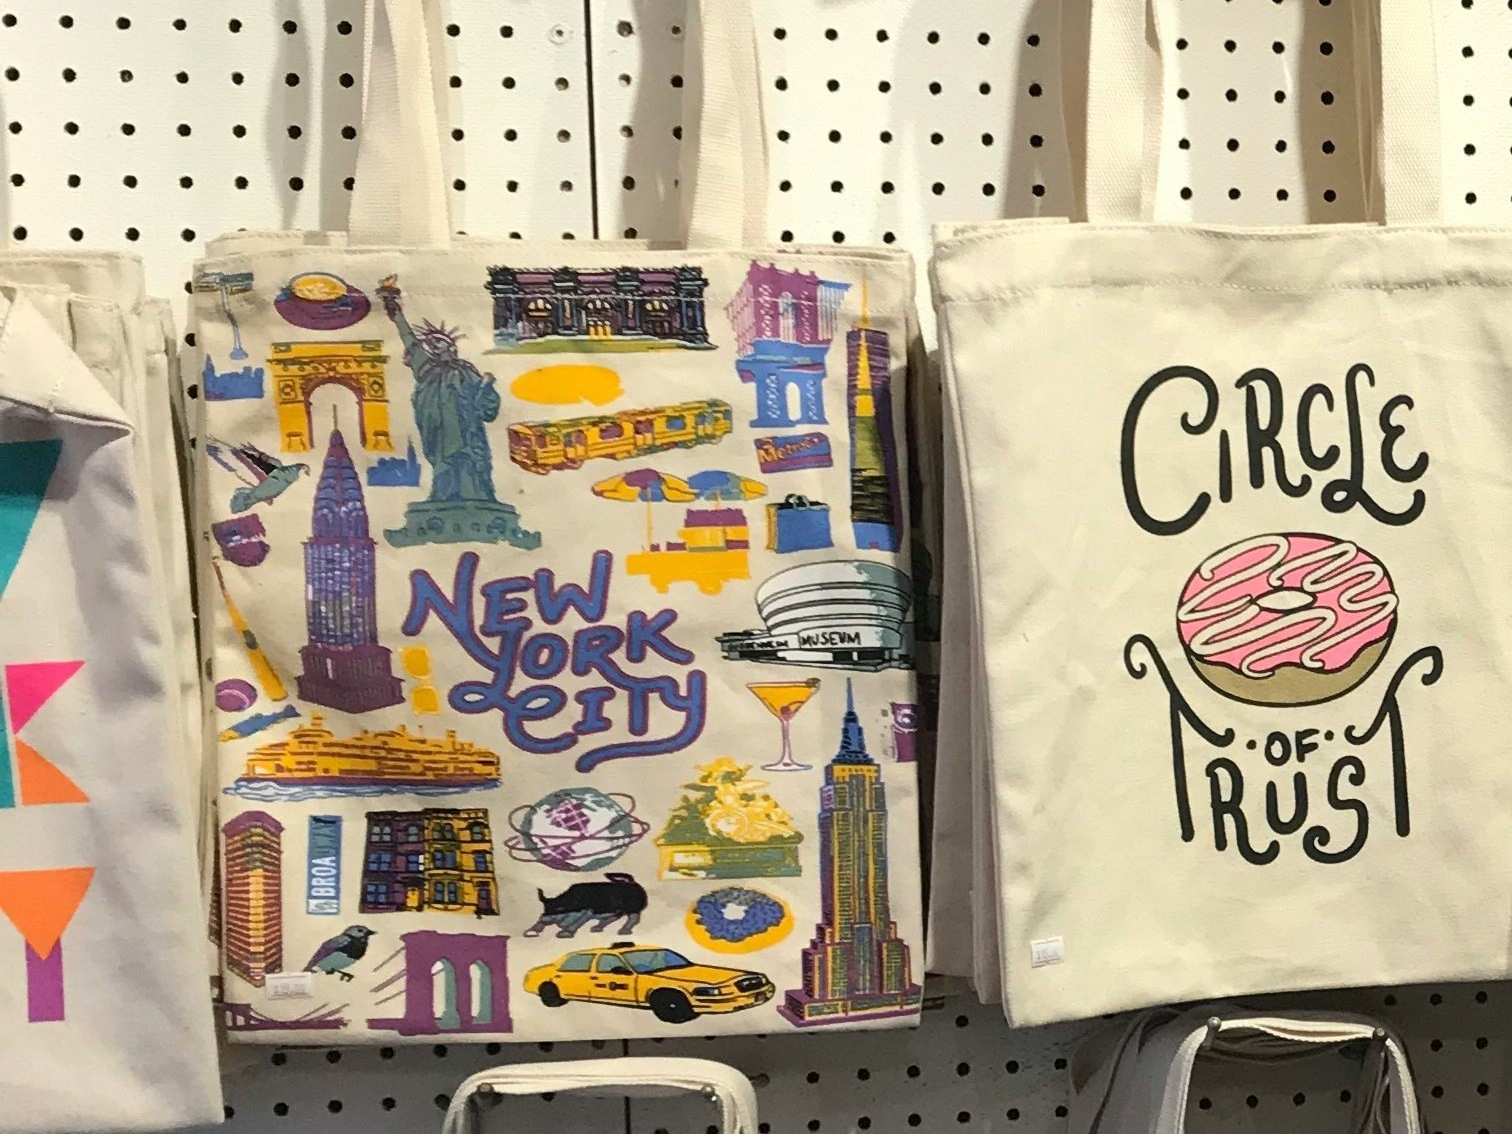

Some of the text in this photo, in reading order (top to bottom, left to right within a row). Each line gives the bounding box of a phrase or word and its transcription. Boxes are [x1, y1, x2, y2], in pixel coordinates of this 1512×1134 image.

[401, 550, 613, 637] NEW
[461, 608, 695, 692] YORK
[448, 669, 708, 774] CITY
[1123, 633, 1444, 866] TRUST
[1263, 728, 1322, 768] OF
